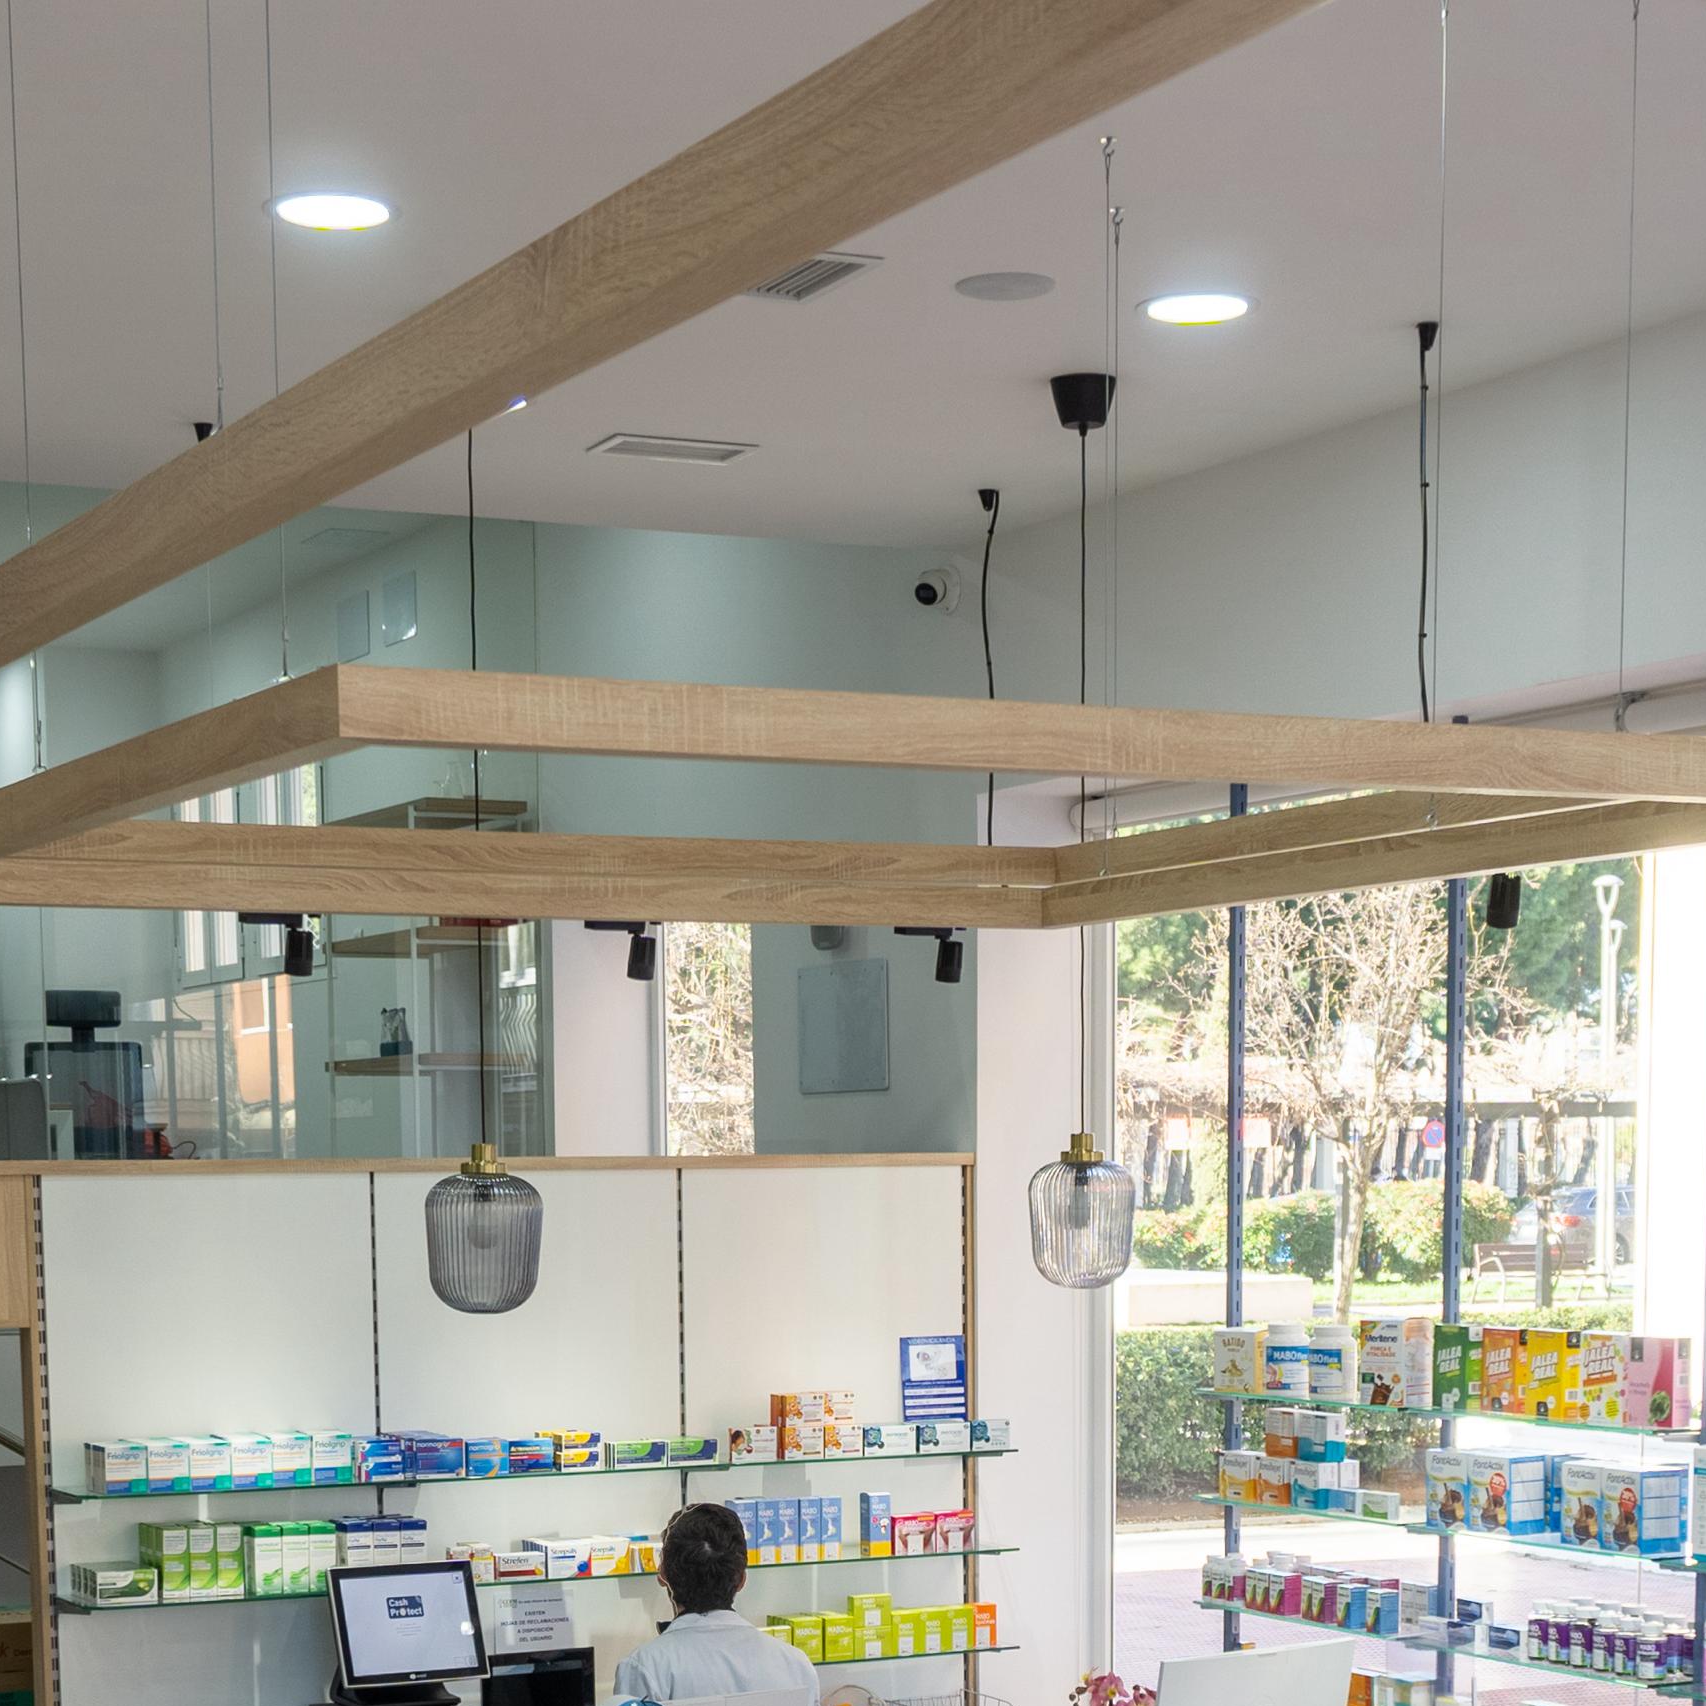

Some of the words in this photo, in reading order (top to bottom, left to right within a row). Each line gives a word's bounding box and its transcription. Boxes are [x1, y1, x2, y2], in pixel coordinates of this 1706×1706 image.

[1437, 1346, 1462, 1359] JALEA
[1486, 1347, 1511, 1365] JALEA
[1532, 1352, 1558, 1368] JALEA
[1583, 1345, 1616, 1363] JALEA
[1440, 1357, 1460, 1374] REAL
[1488, 1361, 1510, 1376] REAL
[1534, 1364, 1557, 1379] REAL
[1588, 1358, 1615, 1374] REAL
[315, 1439, 346, 1450] Friolgrip
[389, 1598, 408, 1607] Cash
